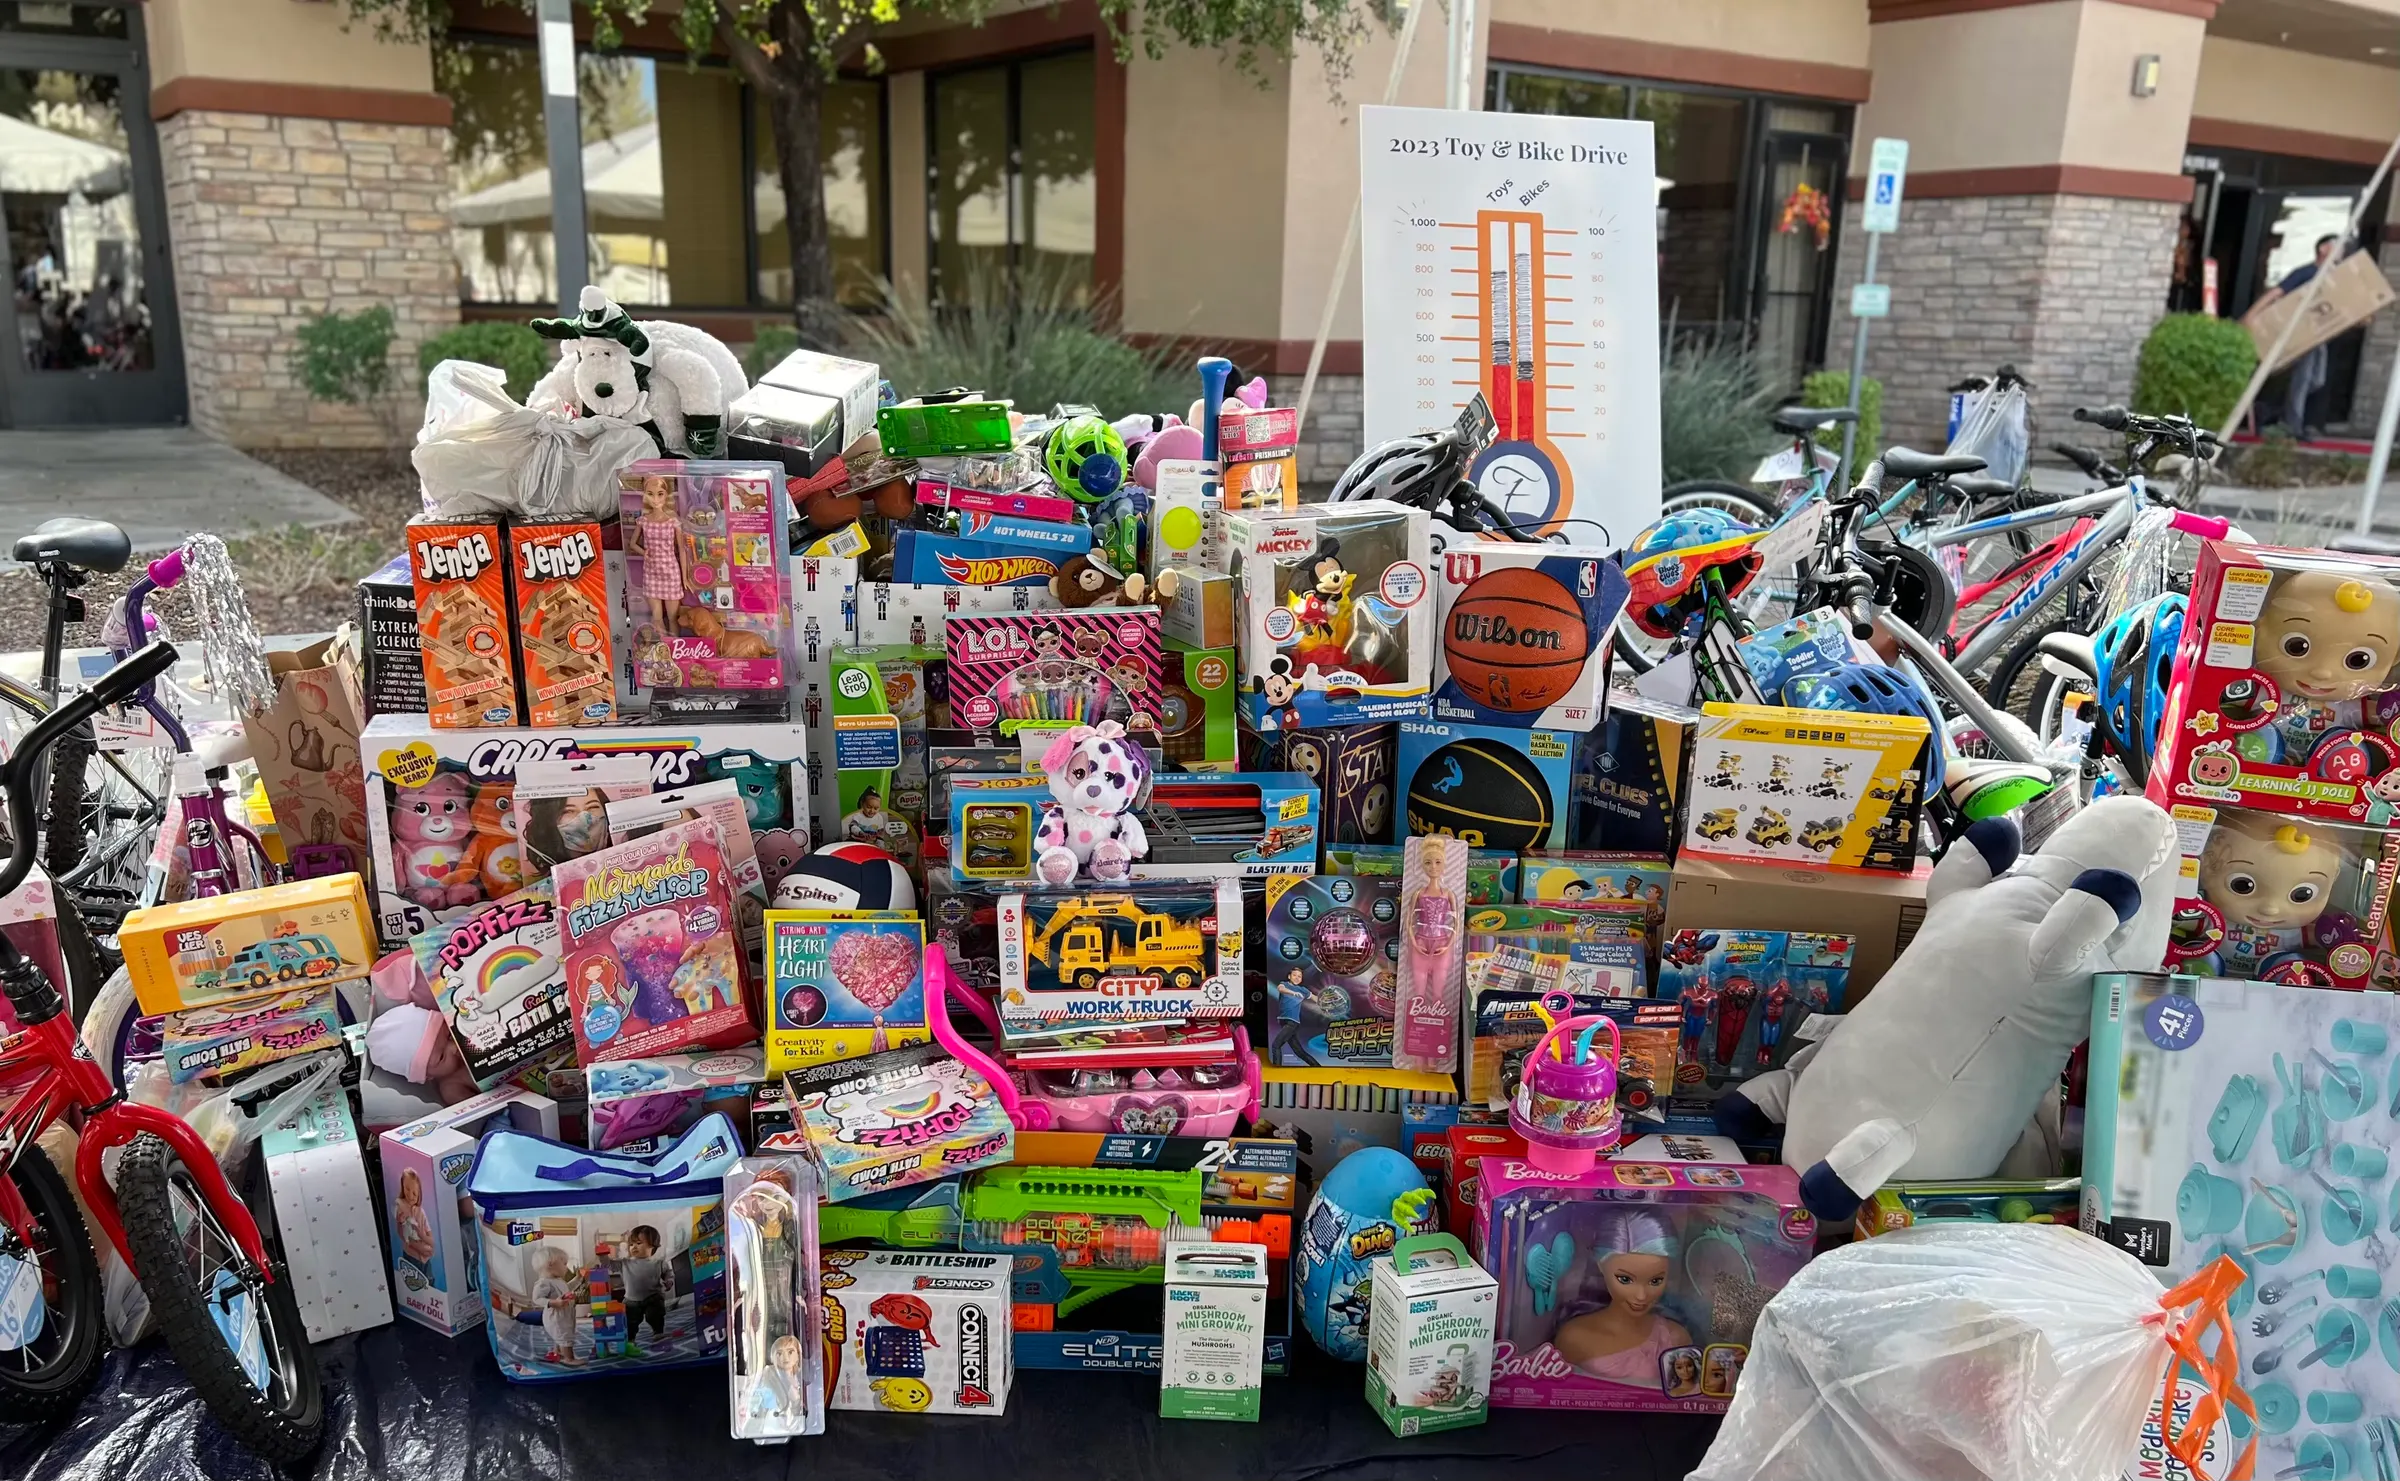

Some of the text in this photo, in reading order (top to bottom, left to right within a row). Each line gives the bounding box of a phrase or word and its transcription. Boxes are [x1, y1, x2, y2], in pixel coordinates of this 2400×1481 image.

[1390, 137, 1628, 165] 2023 Toy & Bike Drive
[1486, 177, 1514, 203] Toys
[1519, 178, 1550, 207] Bikes
[1410, 218, 1436, 228] 1,000
[1588, 228, 1605, 236] 100
[1416, 243, 1435, 252] 900
[1591, 251, 1604, 260] 90
[1415, 265, 1434, 274] 800
[1591, 274, 1604, 283] 80
[1416, 288, 1434, 297] 700
[1592, 296, 1604, 305] 70
[1415, 312, 1435, 321] 600
[1592, 319, 1605, 328] 60
[1416, 334, 1435, 343] 500
[1593, 341, 1606, 350] 50
[1416, 355, 1435, 364] 400
[1593, 361, 1606, 370] 40
[1416, 378, 1435, 387] 300
[1593, 384, 1606, 393] 30
[1416, 400, 1435, 410] 200
[1594, 407, 1606, 416] 20
[1459, 405, 1478, 441] BELL
[1595, 432, 1606, 441] 10
[1256, 539, 1312, 554] MICKEY
[418, 533, 493, 580] Jenga
[520, 531, 595, 578] Jenga
[2013, 540, 2083, 618] HUFFY
[1397, 586, 1410, 594] 15
[1455, 611, 1561, 650] Wilson
[2214, 630, 2250, 640] LEARNING
[2215, 625, 2235, 633] CORE
[376, 636, 422, 648] SCIENCE
[672, 638, 716, 660] Barbie
[968, 651, 1016, 662] SURPRISE!
[1786, 650, 1815, 667] Toddler
[877, 664, 922, 673] umber Puffs
[1202, 663, 1222, 676] 22
[841, 672, 864, 686] Leap
[1202, 676, 1222, 684] Pieces
[844, 681, 867, 696] Frog
[972, 704, 990, 712] 100
[1357, 701, 1428, 713] TALKING MUSICAL
[1368, 707, 1417, 719] ROOM GLOW
[1437, 707, 1476, 720] BASKETBALL
[1400, 722, 1450, 736] SHAQ
[1530, 741, 1566, 751] BASKETBALL
[396, 750, 417, 764] FOUR
[469, 739, 573, 777] CARE
[1529, 750, 1564, 759] COLLECTION
[387, 755, 435, 779] EXCLUSIVE
[404, 771, 430, 784] BEARS!
[2177, 784, 2239, 801] CoComelon
[2239, 776, 2350, 799] LEARNING JJ DOLL
[1407, 810, 1486, 848] SHAQ
[582, 841, 695, 906] Mermaid
[1246, 864, 1310, 874] BLASTIN' RIG
[386, 914, 402, 925] SET
[403, 906, 425, 935] 5
[391, 923, 402, 935] OF
[781, 926, 822, 935] STRING ART
[778, 937, 827, 958] HEART
[2337, 950, 2366, 965] 50+
[776, 960, 827, 980] LIGHT
[1066, 999, 1194, 1015] WORK TRUCK
[1409, 996, 1450, 1017] Barbie
[2158, 1006, 2186, 1037] 41
[2176, 1012, 2195, 1040] Pieces
[1327, 1021, 1394, 1040] wonde
[775, 1037, 827, 1048] Creativity
[784, 1046, 825, 1057] for Kids
[1111, 1138, 1136, 1146] MOTORIZED
[1244, 1148, 1292, 1157] ALTERNATING BARRELS
[850, 1155, 921, 1186] BATH BOMB
[1025, 1218, 1101, 1230] DOUBLE
[1886, 1213, 1905, 1224] 25
[513, 1223, 533, 1235] MEGA
[513, 1230, 545, 1246] BLOKS
[1025, 1231, 1101, 1243] PUNCH
[2138, 1226, 2148, 1258] Member's
[890, 1254, 997, 1269] BATTLESHIP
[406, 1296, 445, 1321] BABY DOLL
[1409, 1307, 1438, 1315] ROOTS
[1410, 1301, 1429, 1309] BACK
[1184, 1310, 1246, 1323] MUSHROOM
[1427, 1312, 1453, 1323] ORGANIC
[1176, 1319, 1254, 1334] MINI GROW KIT
[1418, 1316, 1482, 1336] MUSHROOM
[1095, 1336, 1120, 1346] NERF
[1409, 1327, 1490, 1350] MINI GROW KIT
[1191, 1341, 1236, 1349] MUSHROOMS!
[958, 1306, 991, 1405] CONNECT 4
